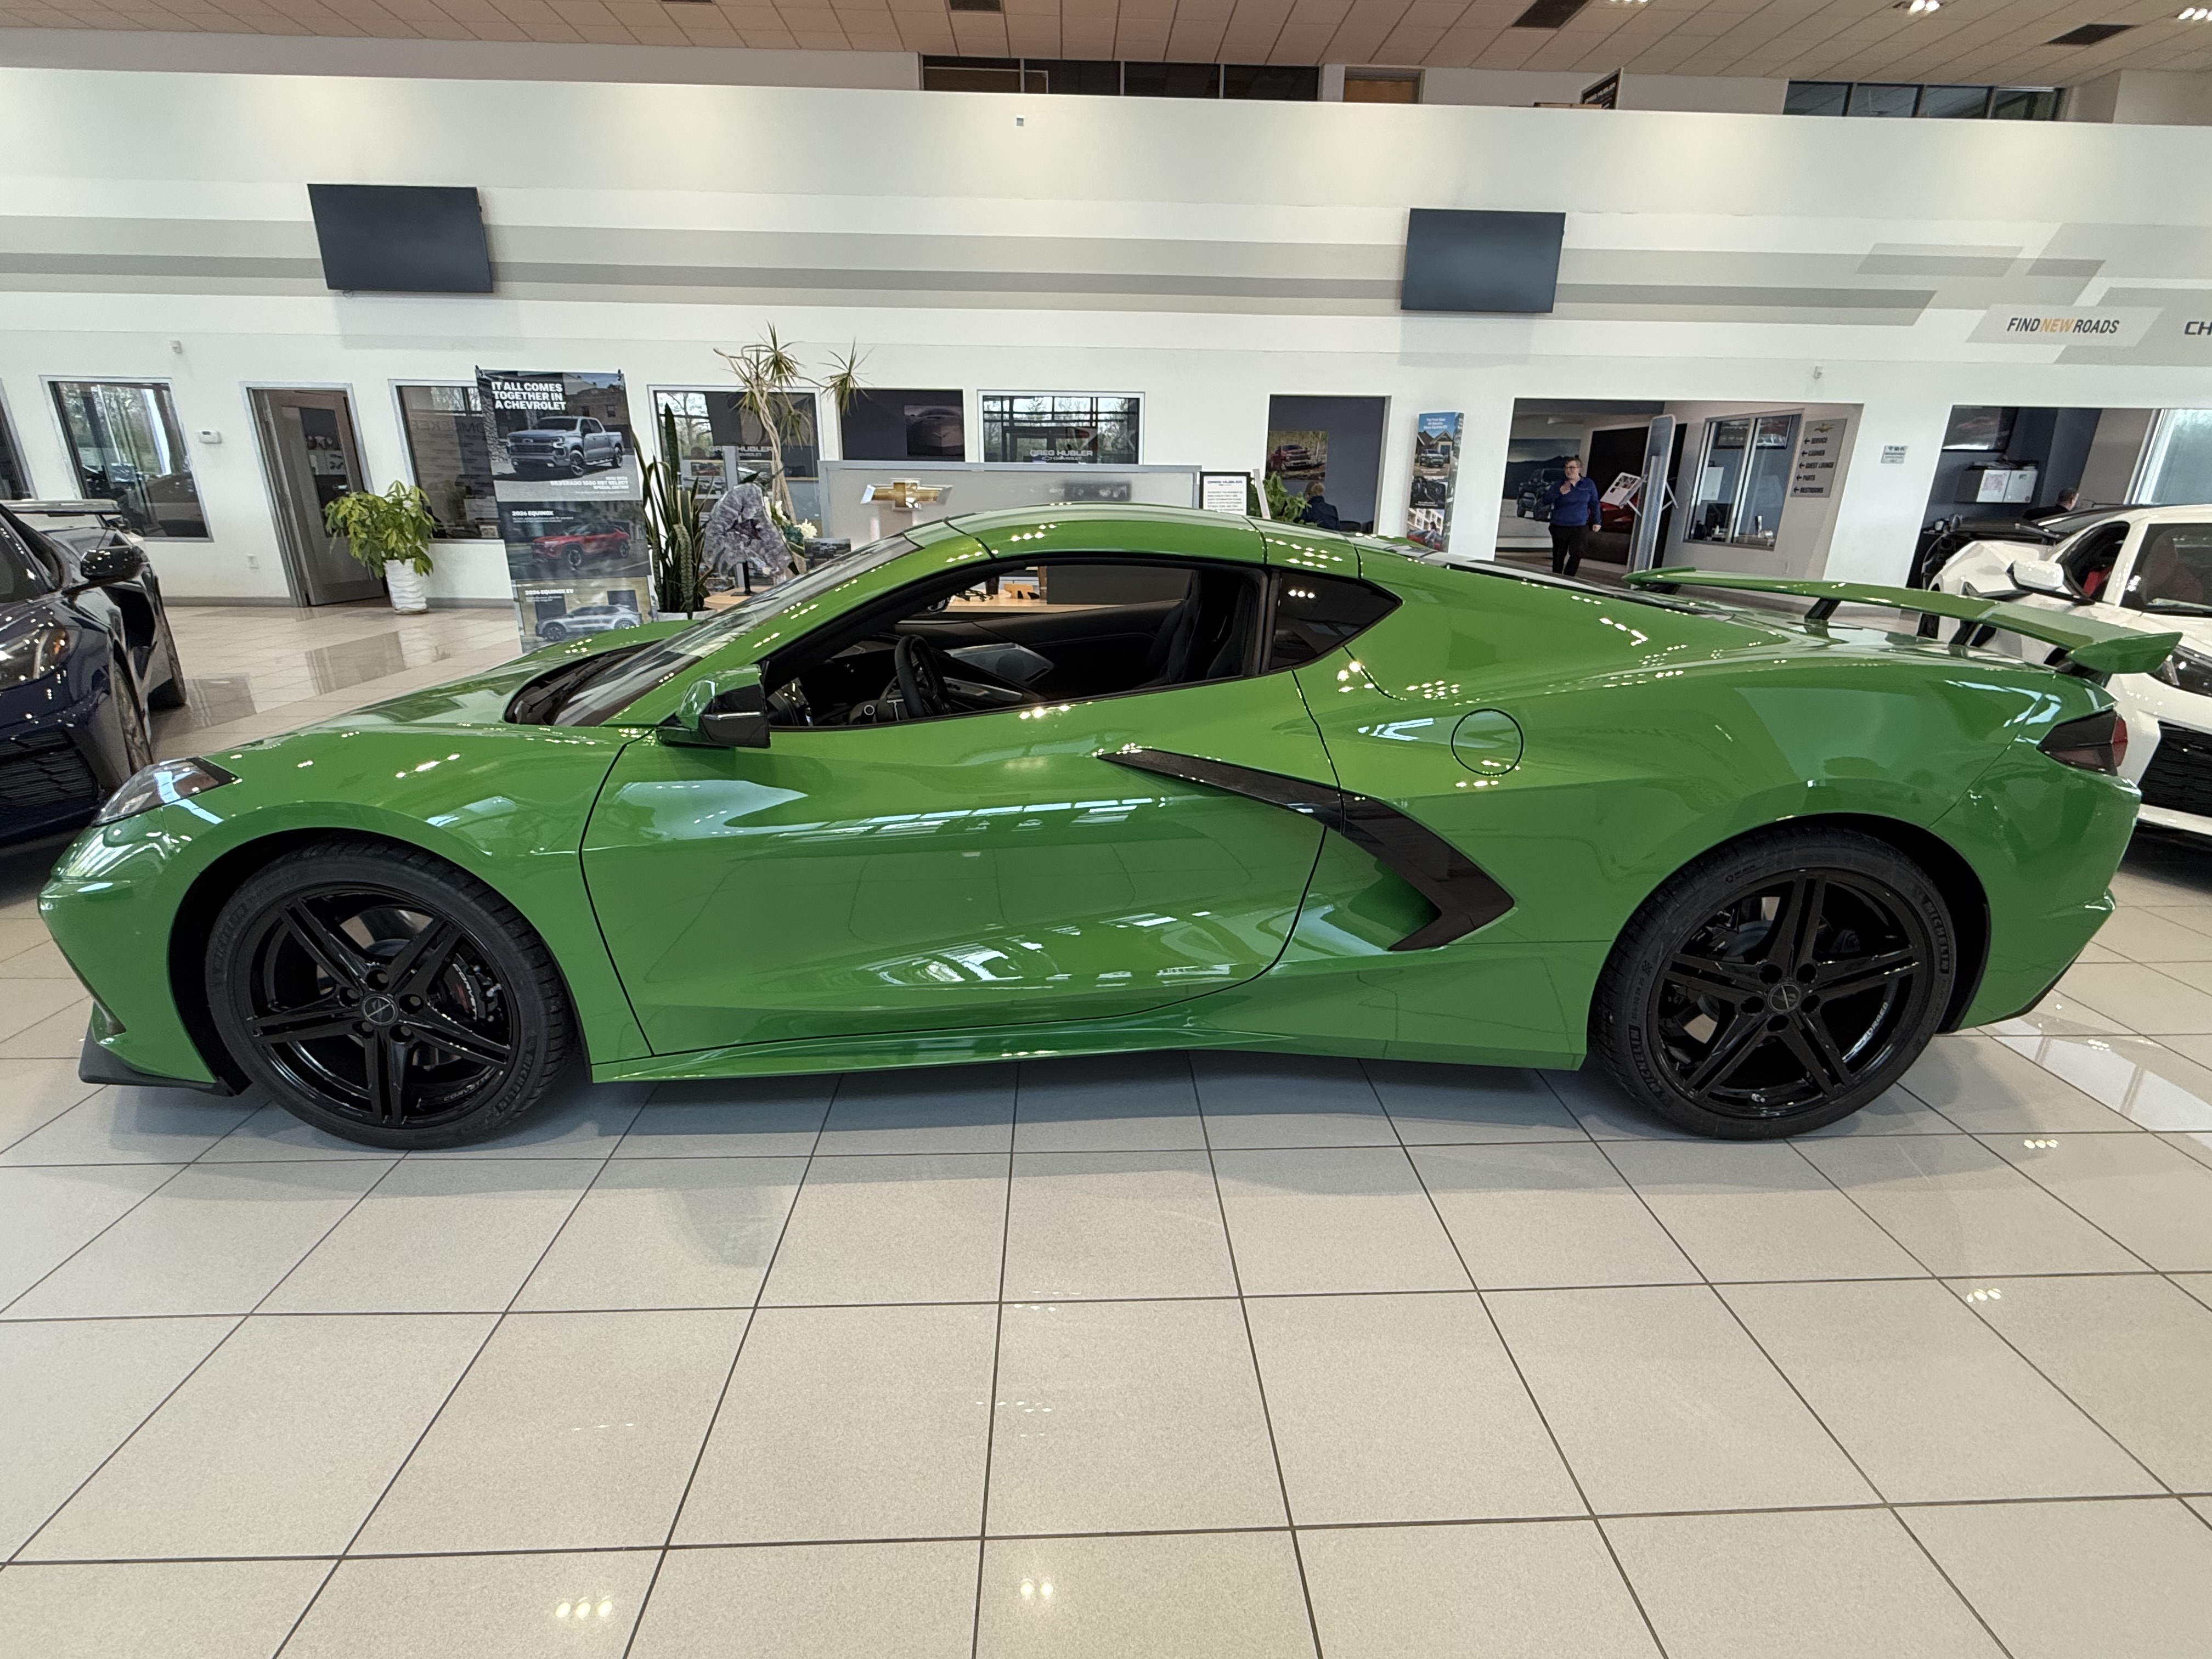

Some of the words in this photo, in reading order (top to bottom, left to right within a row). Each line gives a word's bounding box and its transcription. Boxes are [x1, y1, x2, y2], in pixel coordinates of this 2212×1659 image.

[2006, 318, 2041, 332] FIND
[2040, 318, 2075, 332] NEW
[2073, 319, 2120, 334] ROADS
[491, 381, 503, 391] IT
[504, 382, 523, 391] ALL
[524, 383, 563, 392] COMES
[492, 391, 550, 400] TOGETHER
[550, 392, 563, 401] IN
[495, 400, 504, 409] A
[504, 400, 566, 410] CHEVROLET
[1923, 901, 1949, 970] MICHELIN
[1629, 1029, 1661, 1093] MICHELIN
